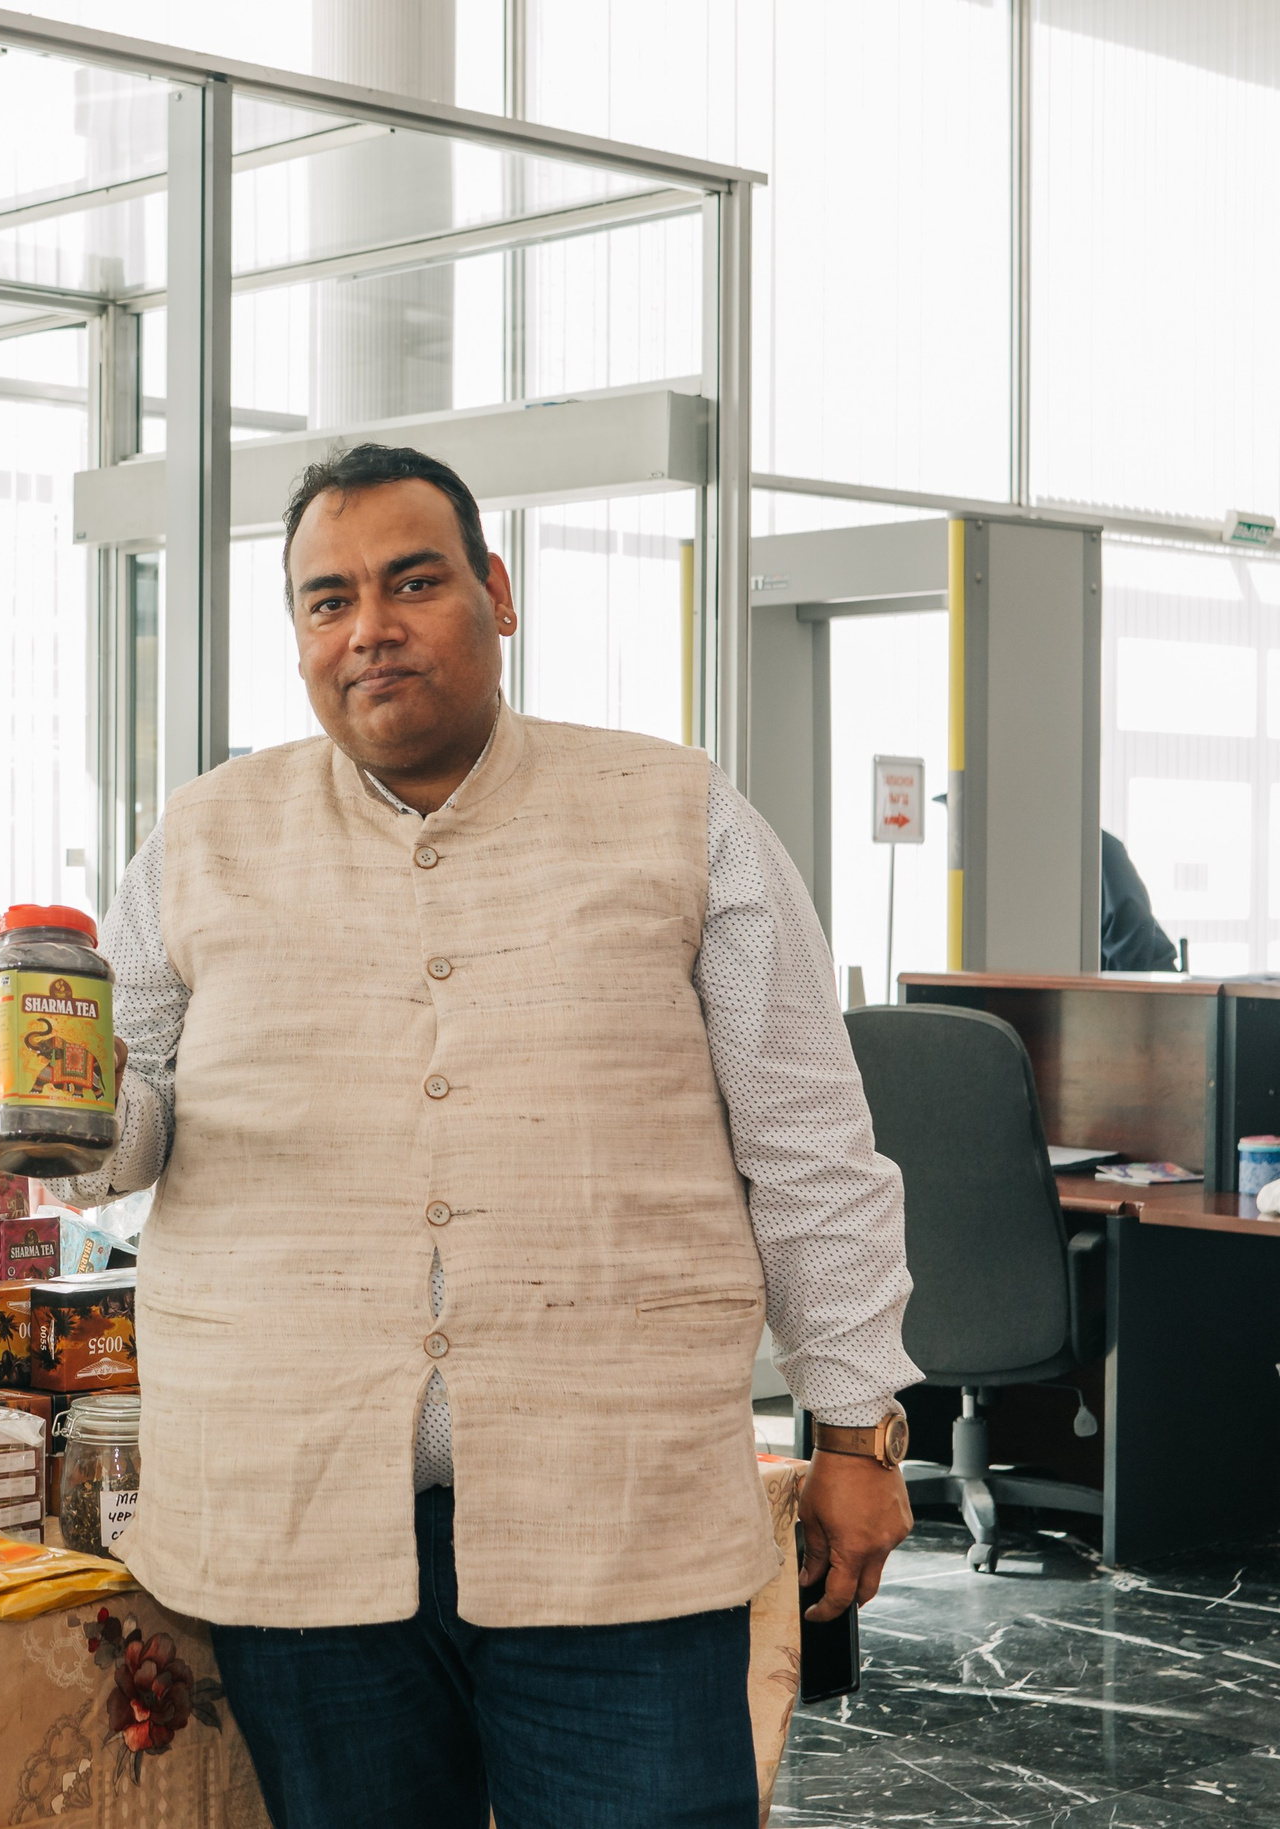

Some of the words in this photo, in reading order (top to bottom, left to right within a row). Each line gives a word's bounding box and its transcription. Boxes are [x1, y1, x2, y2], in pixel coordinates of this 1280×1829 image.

[24, 996, 74, 1015] SHARMA
[76, 1000, 97, 1018] TEA
[10, 1246, 40, 1259] SHARMA
[40, 1244, 55, 1256] TEA
[77, 1238, 93, 1274] SHARMA
[88, 1335, 123, 1355] 0055
